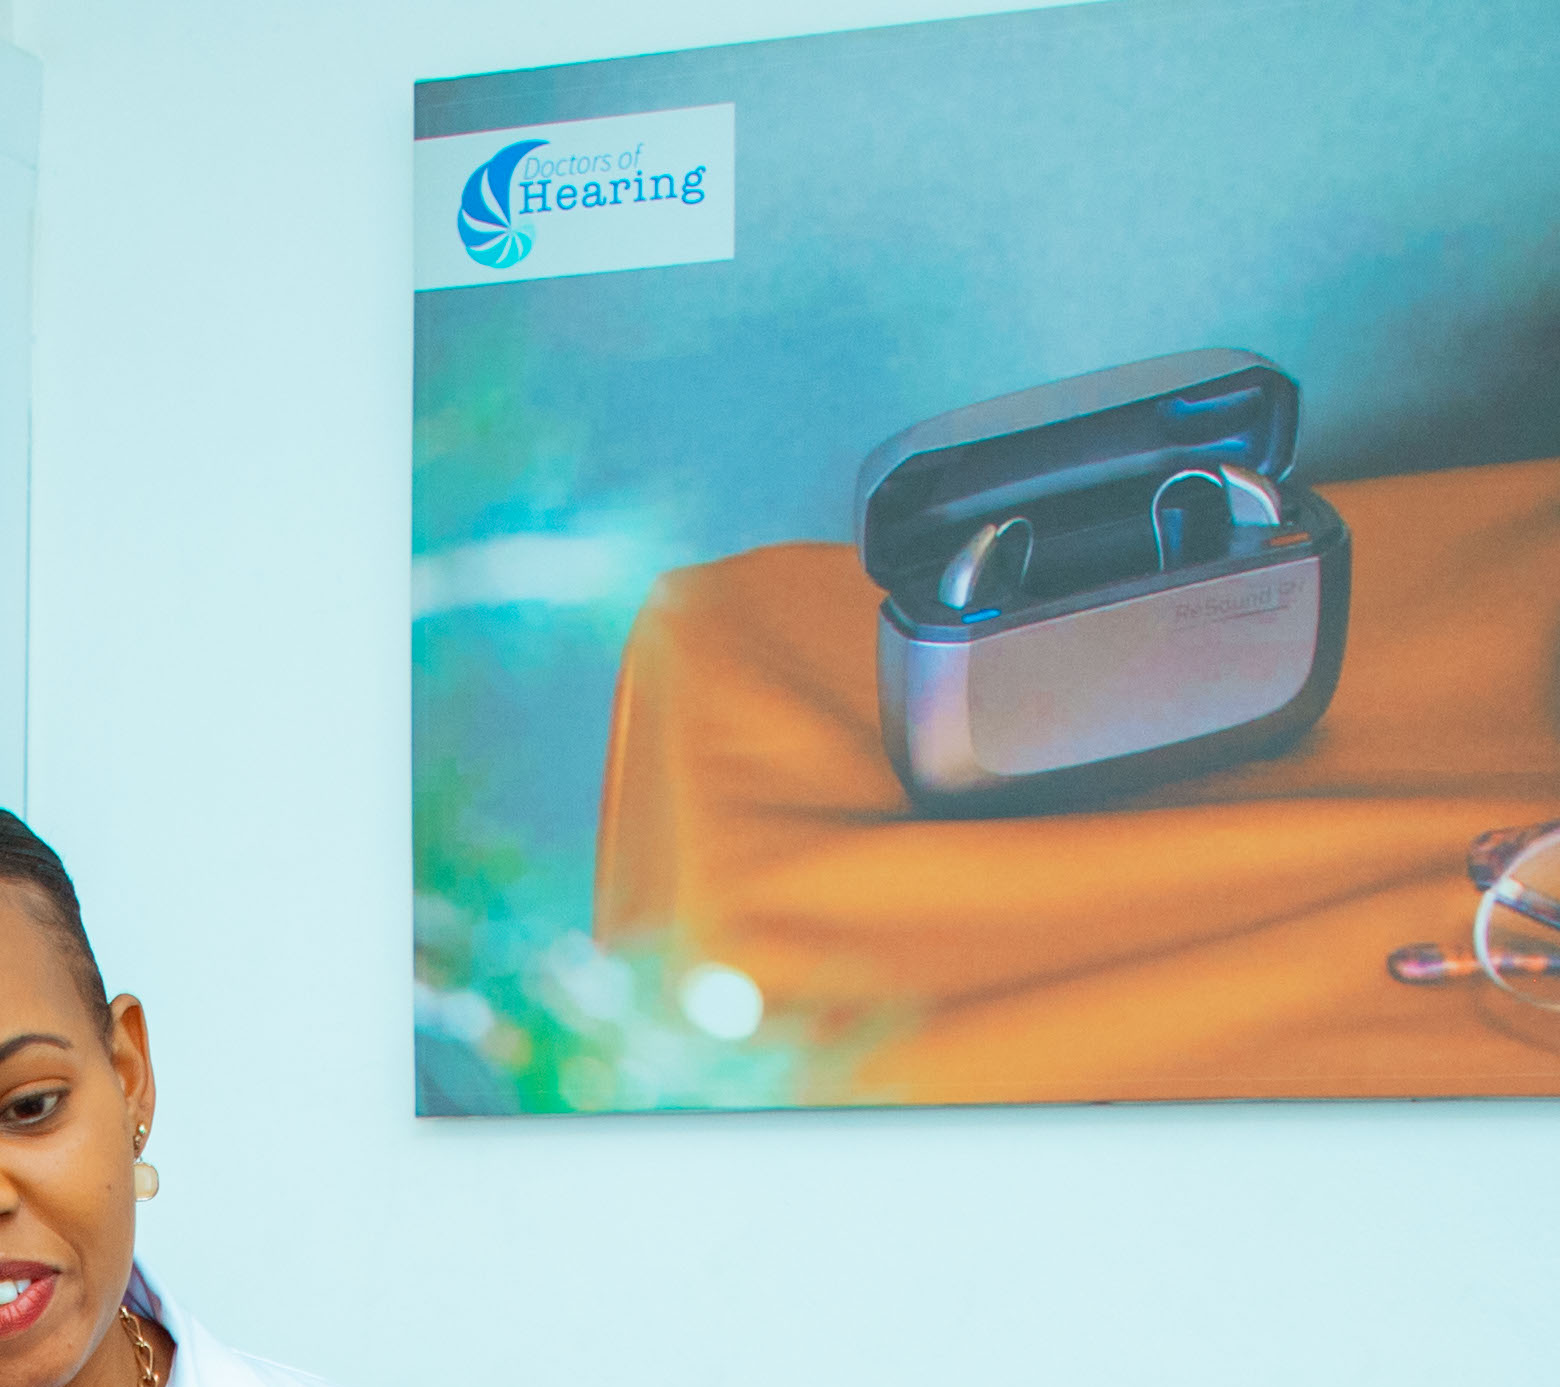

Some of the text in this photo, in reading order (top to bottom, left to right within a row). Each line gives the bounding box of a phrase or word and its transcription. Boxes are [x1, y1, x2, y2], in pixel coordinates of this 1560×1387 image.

[524, 141, 645, 181] Doctors of
[518, 164, 707, 216] Hearing
